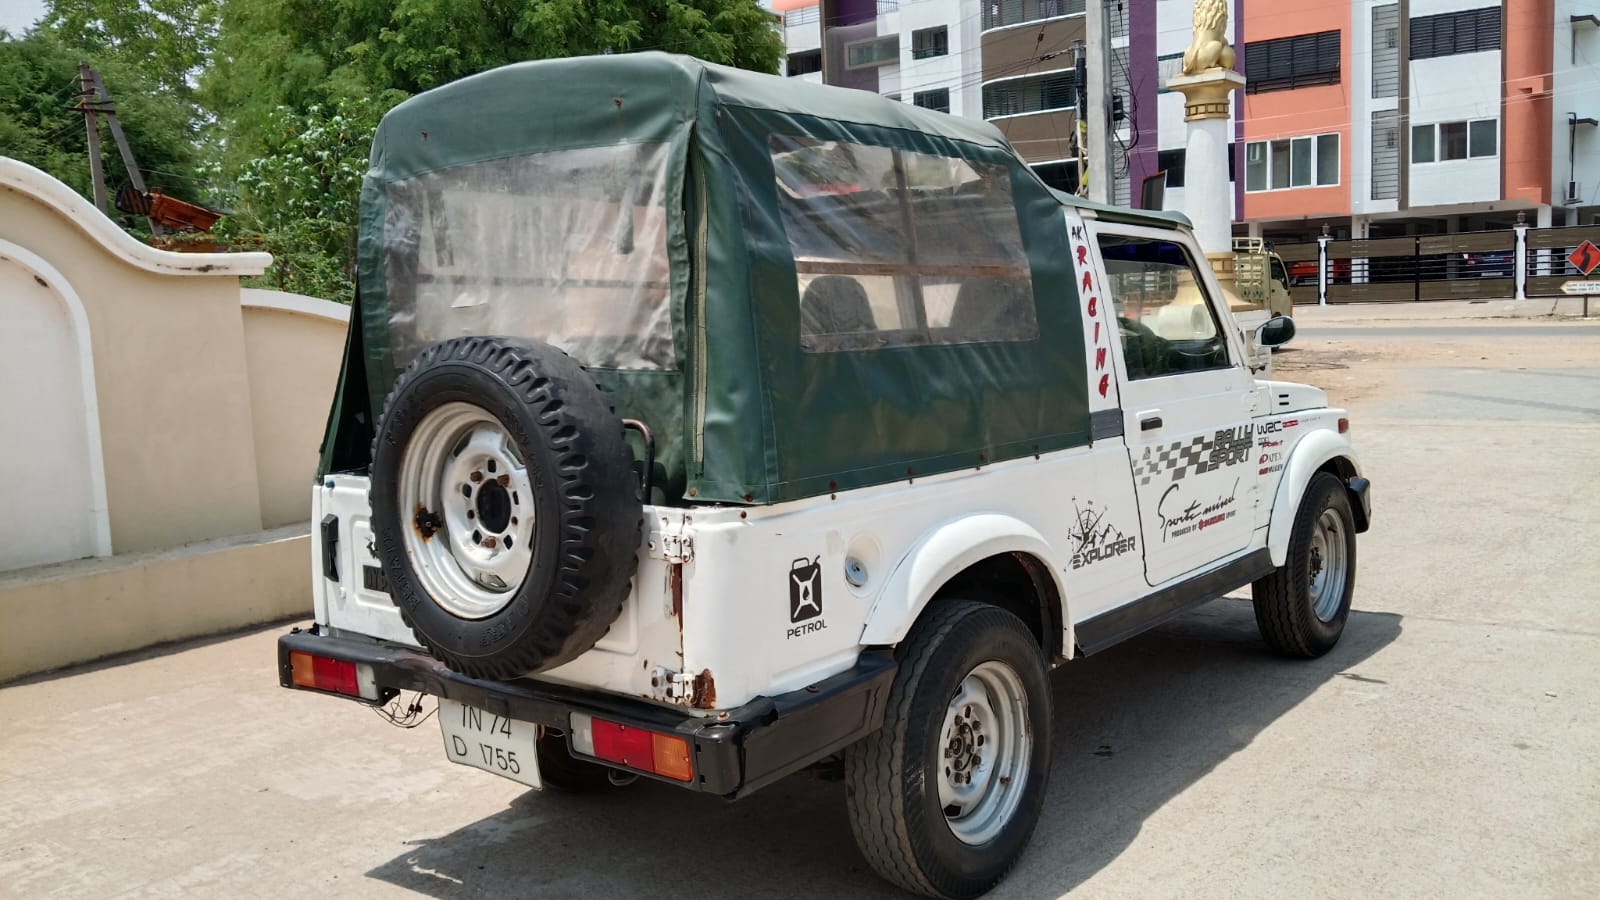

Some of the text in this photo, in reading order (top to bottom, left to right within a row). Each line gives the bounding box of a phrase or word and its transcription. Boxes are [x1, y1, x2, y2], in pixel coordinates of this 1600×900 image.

[1071, 225, 1083, 240] AK
[1076, 245, 1110, 399] RACING
[1213, 423, 1254, 449] RALLY
[1257, 421, 1282, 435] WRC
[1207, 442, 1253, 471] SPORT
[1072, 536, 1136, 570] EXPLORER
[787, 619, 828, 640] PETROL
[461, 703, 481, 731] TN
[452, 734, 520, 774] D 1755
